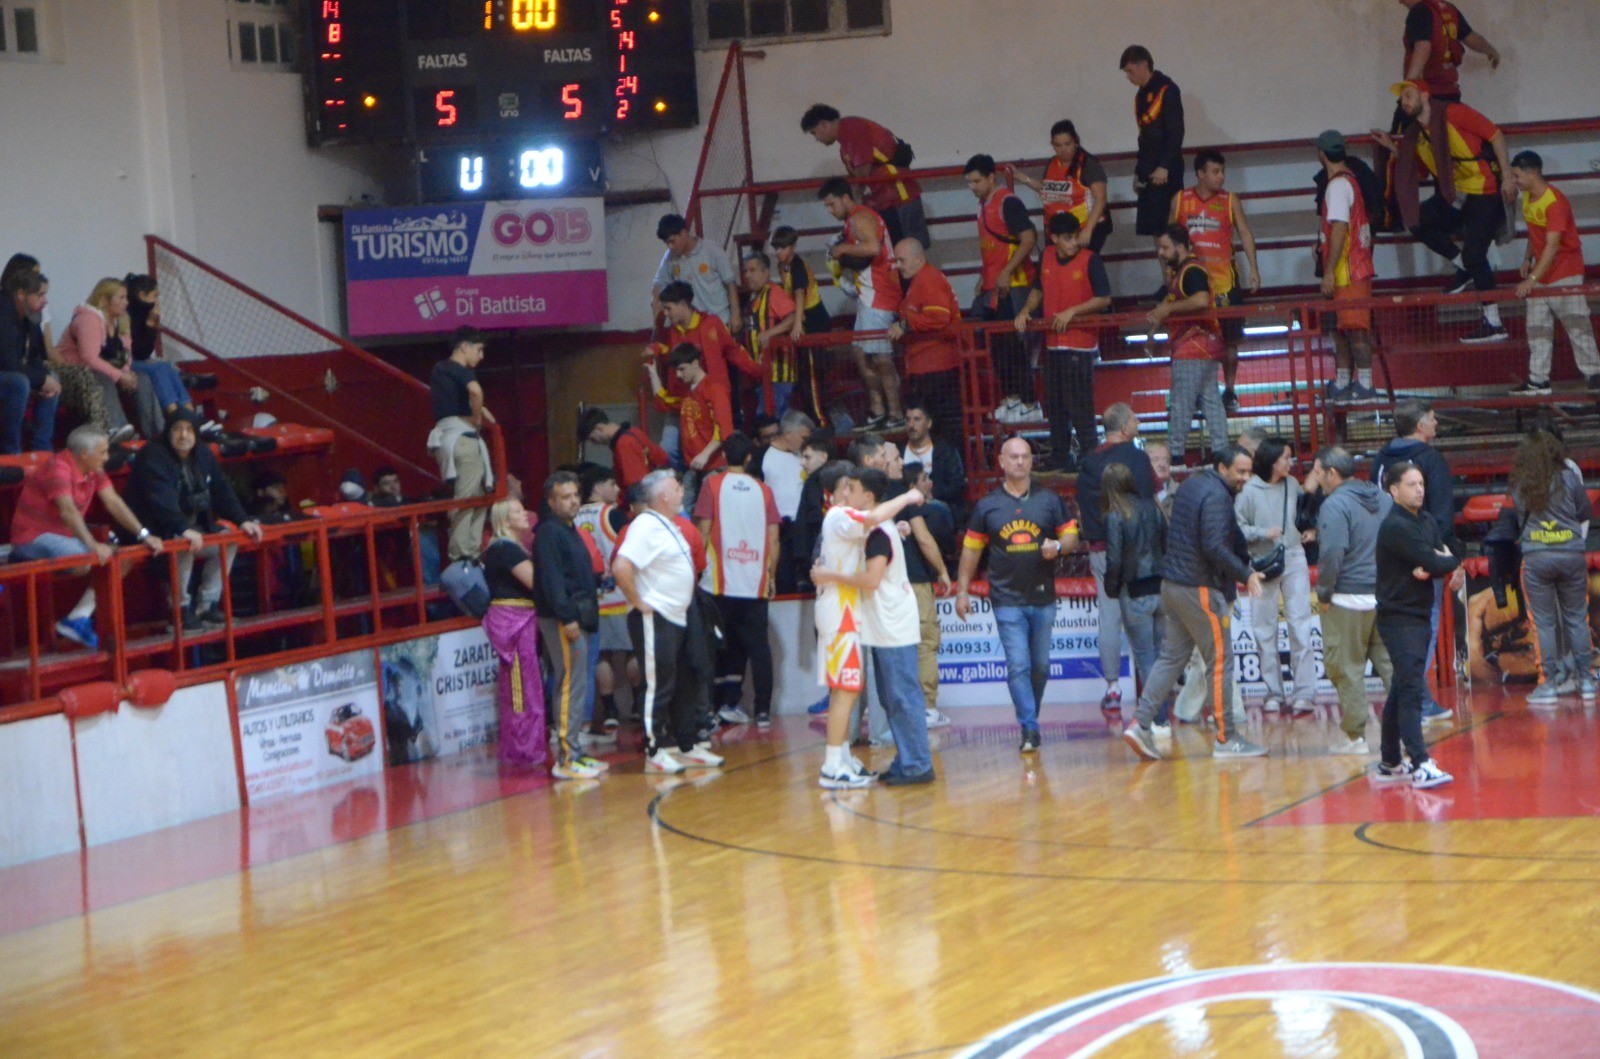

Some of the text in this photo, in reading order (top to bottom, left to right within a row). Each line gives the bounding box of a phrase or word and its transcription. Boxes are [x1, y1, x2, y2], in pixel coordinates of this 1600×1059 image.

[610, 9, 622, 28] 5
[328, 23, 341, 43] 8
[619, 31, 634, 50] 14
[418, 53, 468, 69] FALTAS
[544, 48, 592, 63] FALTAS
[615, 75, 638, 96] 24
[435, 90, 457, 126] 5
[562, 83, 583, 119] 5
[616, 99, 629, 120] 2
[362, 223, 392, 233] Battista
[351, 230, 468, 260] TURISMO
[455, 287, 480, 297] Grupo
[455, 295, 547, 316] Di Battista
[435, 664, 499, 695] CRISTALES
[841, 667, 861, 685] 23
[242, 717, 269, 737] AUTOS
